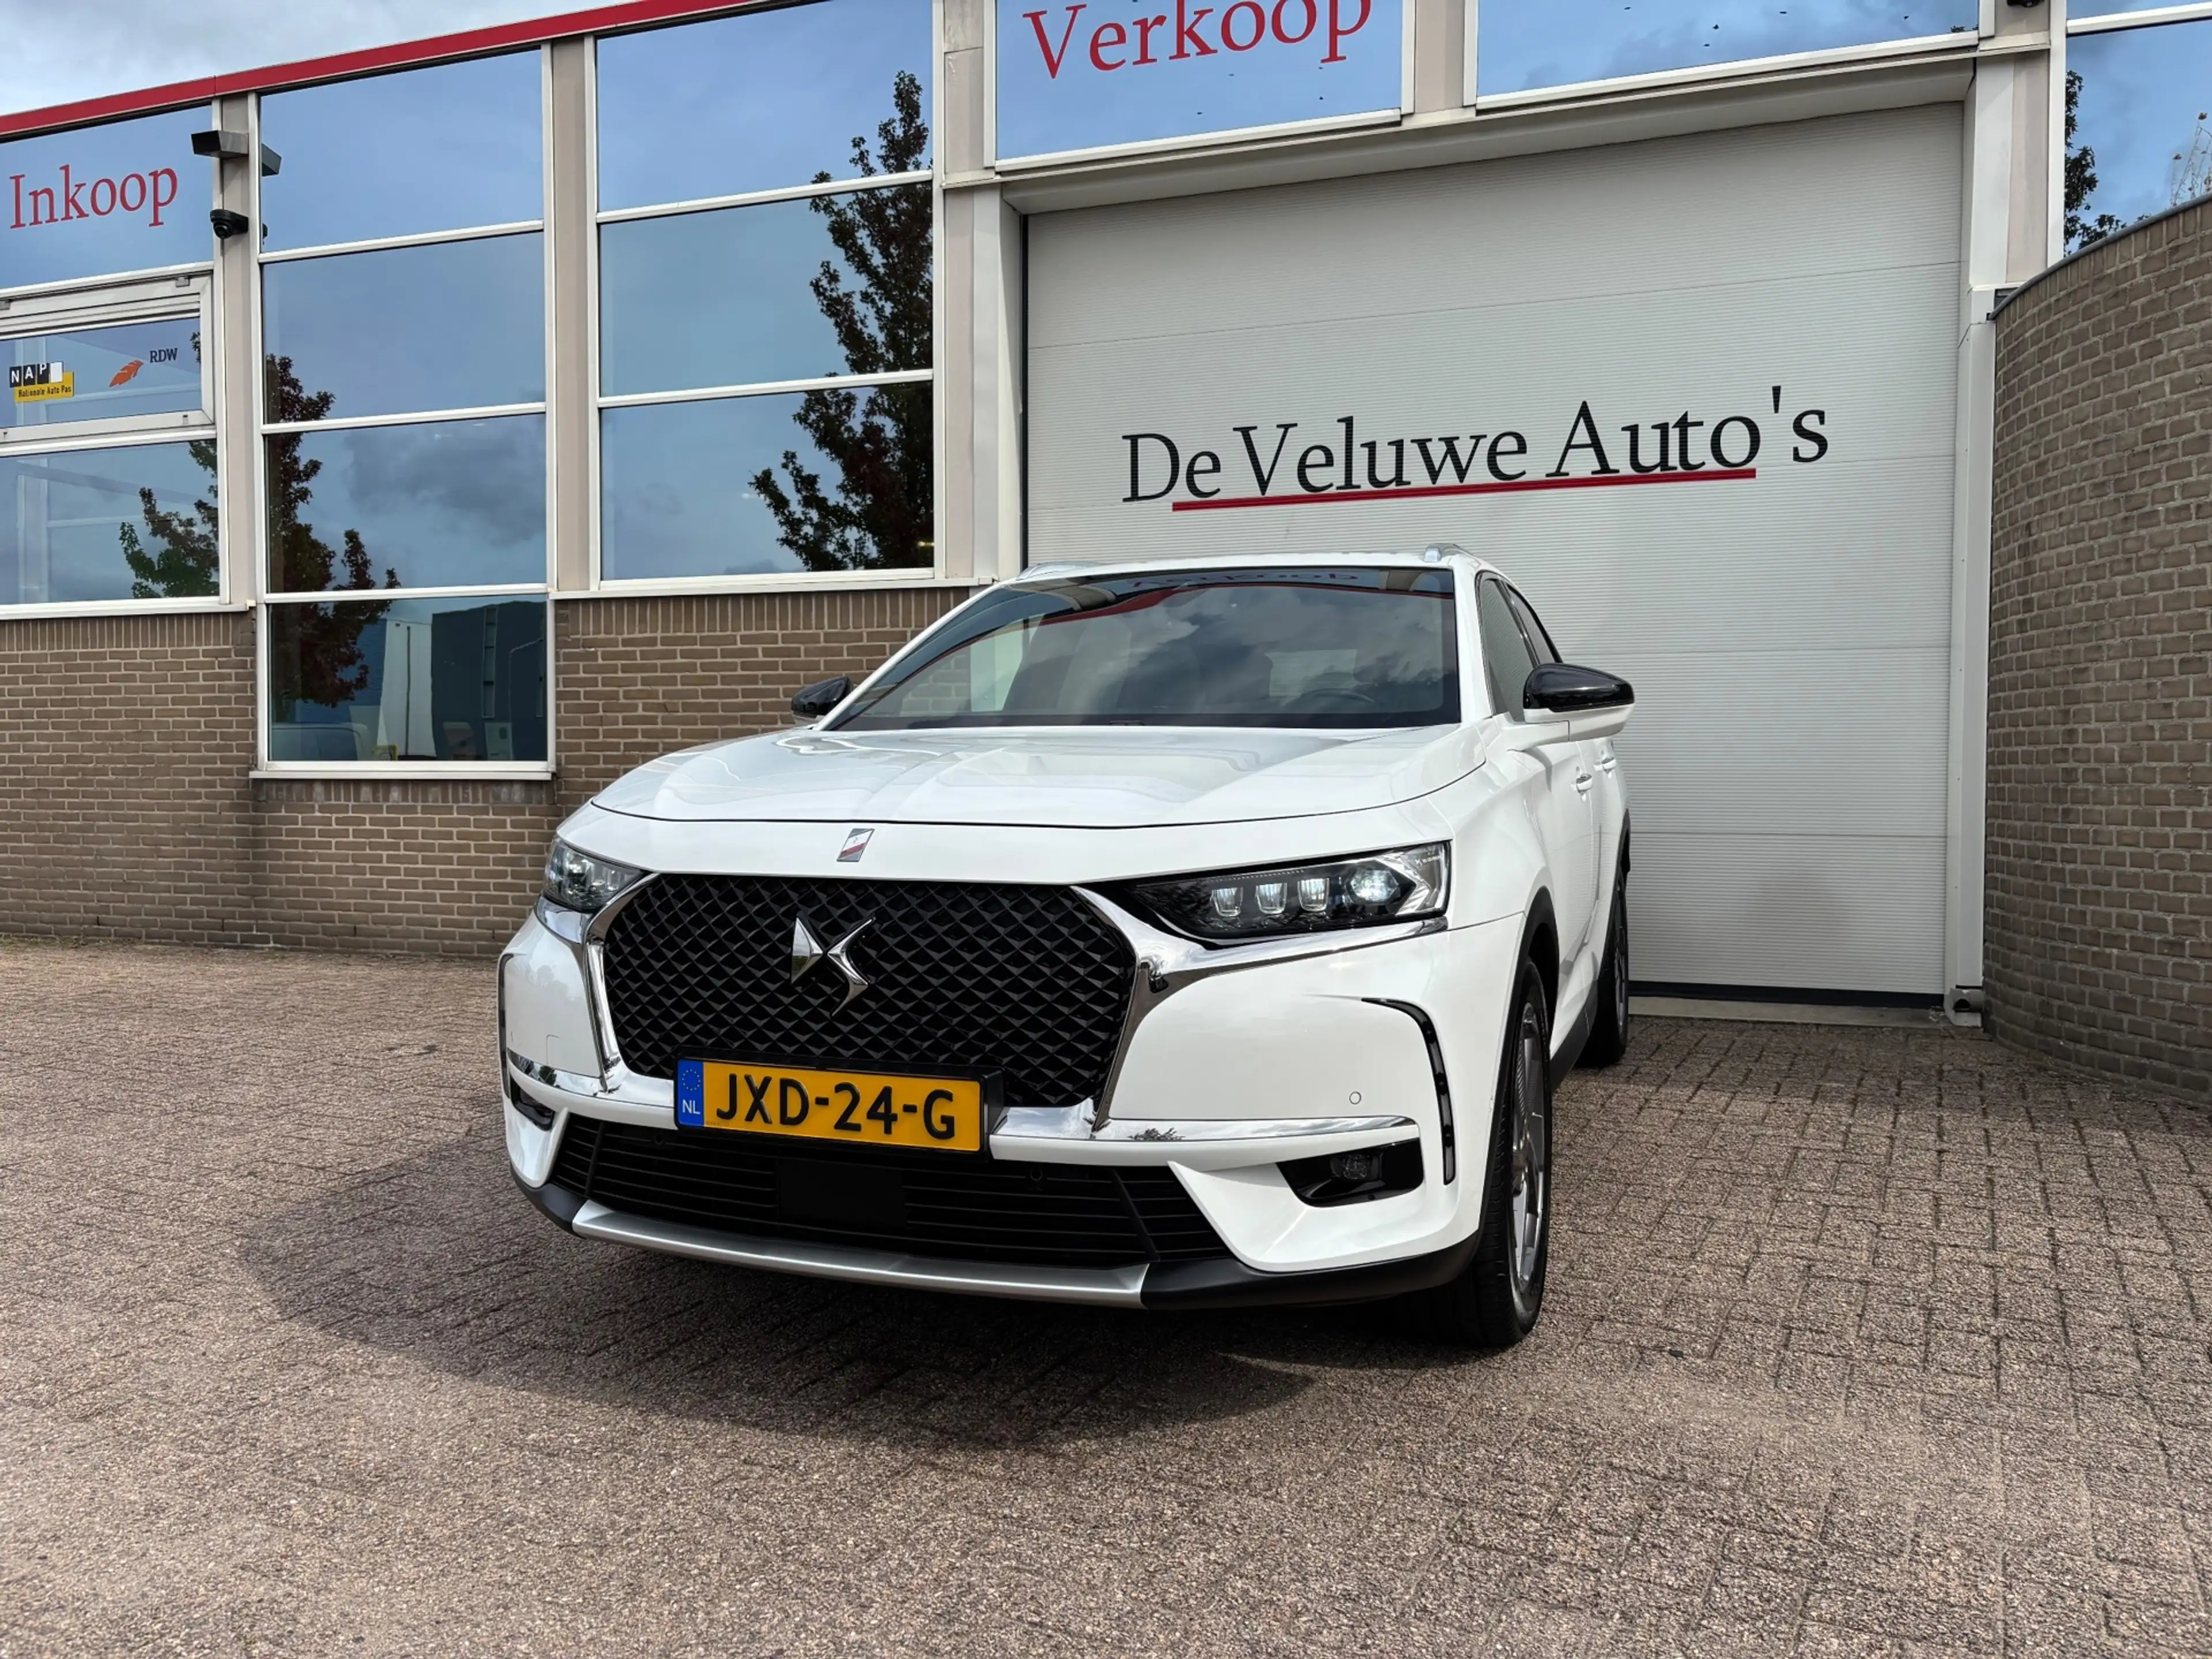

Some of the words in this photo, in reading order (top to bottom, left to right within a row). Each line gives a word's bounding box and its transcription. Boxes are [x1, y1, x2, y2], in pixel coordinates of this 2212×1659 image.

[1023, 0, 1372, 78] Verkoop
[10, 164, 178, 229] Inkoop
[12, 363, 47, 384] NAP
[150, 347, 178, 363] RDW
[61, 384, 72, 393] Pas
[1122, 433, 1222, 502] De
[1232, 415, 1528, 496] Veluwe
[1545, 385, 1828, 478] Auto's
[682, 1099, 701, 1115] NL
[716, 1073, 956, 1141] JXD-24-G
